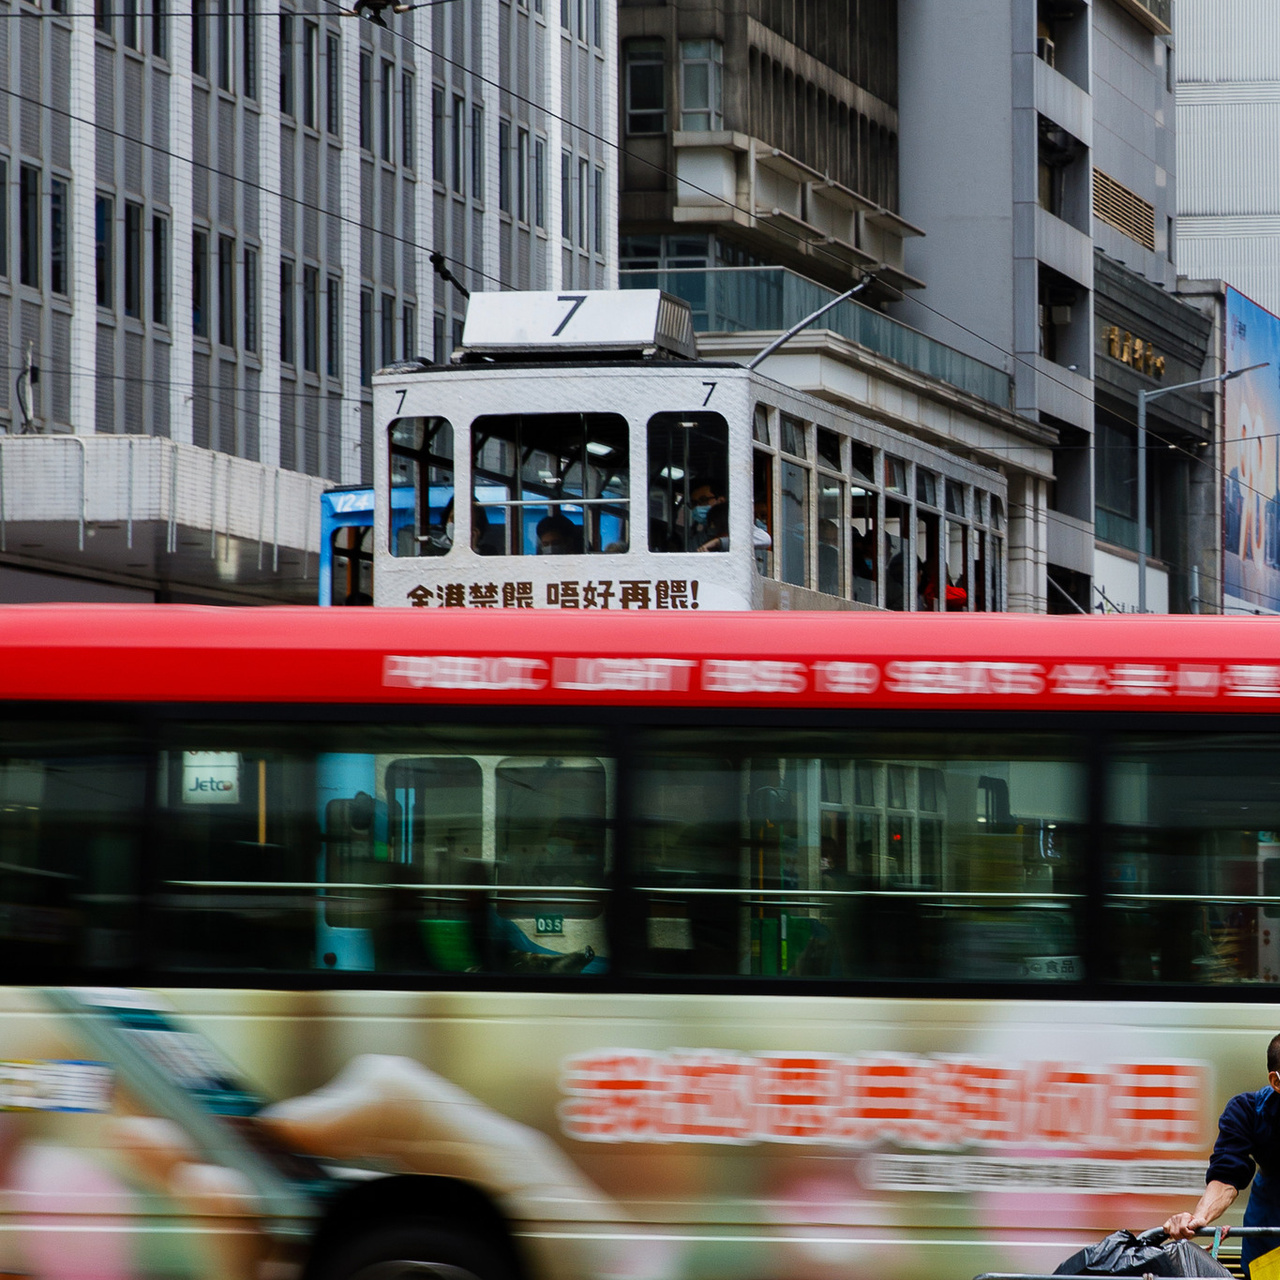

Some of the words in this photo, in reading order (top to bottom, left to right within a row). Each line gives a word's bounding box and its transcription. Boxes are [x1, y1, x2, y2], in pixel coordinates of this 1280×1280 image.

[551, 295, 588, 337] 7
[394, 388, 408, 415] 7
[702, 381, 718, 407] 7
[336, 493, 369, 513] 124
[546, 579, 700, 610] 唔好再餵!
[537, 918, 562, 931] 035
